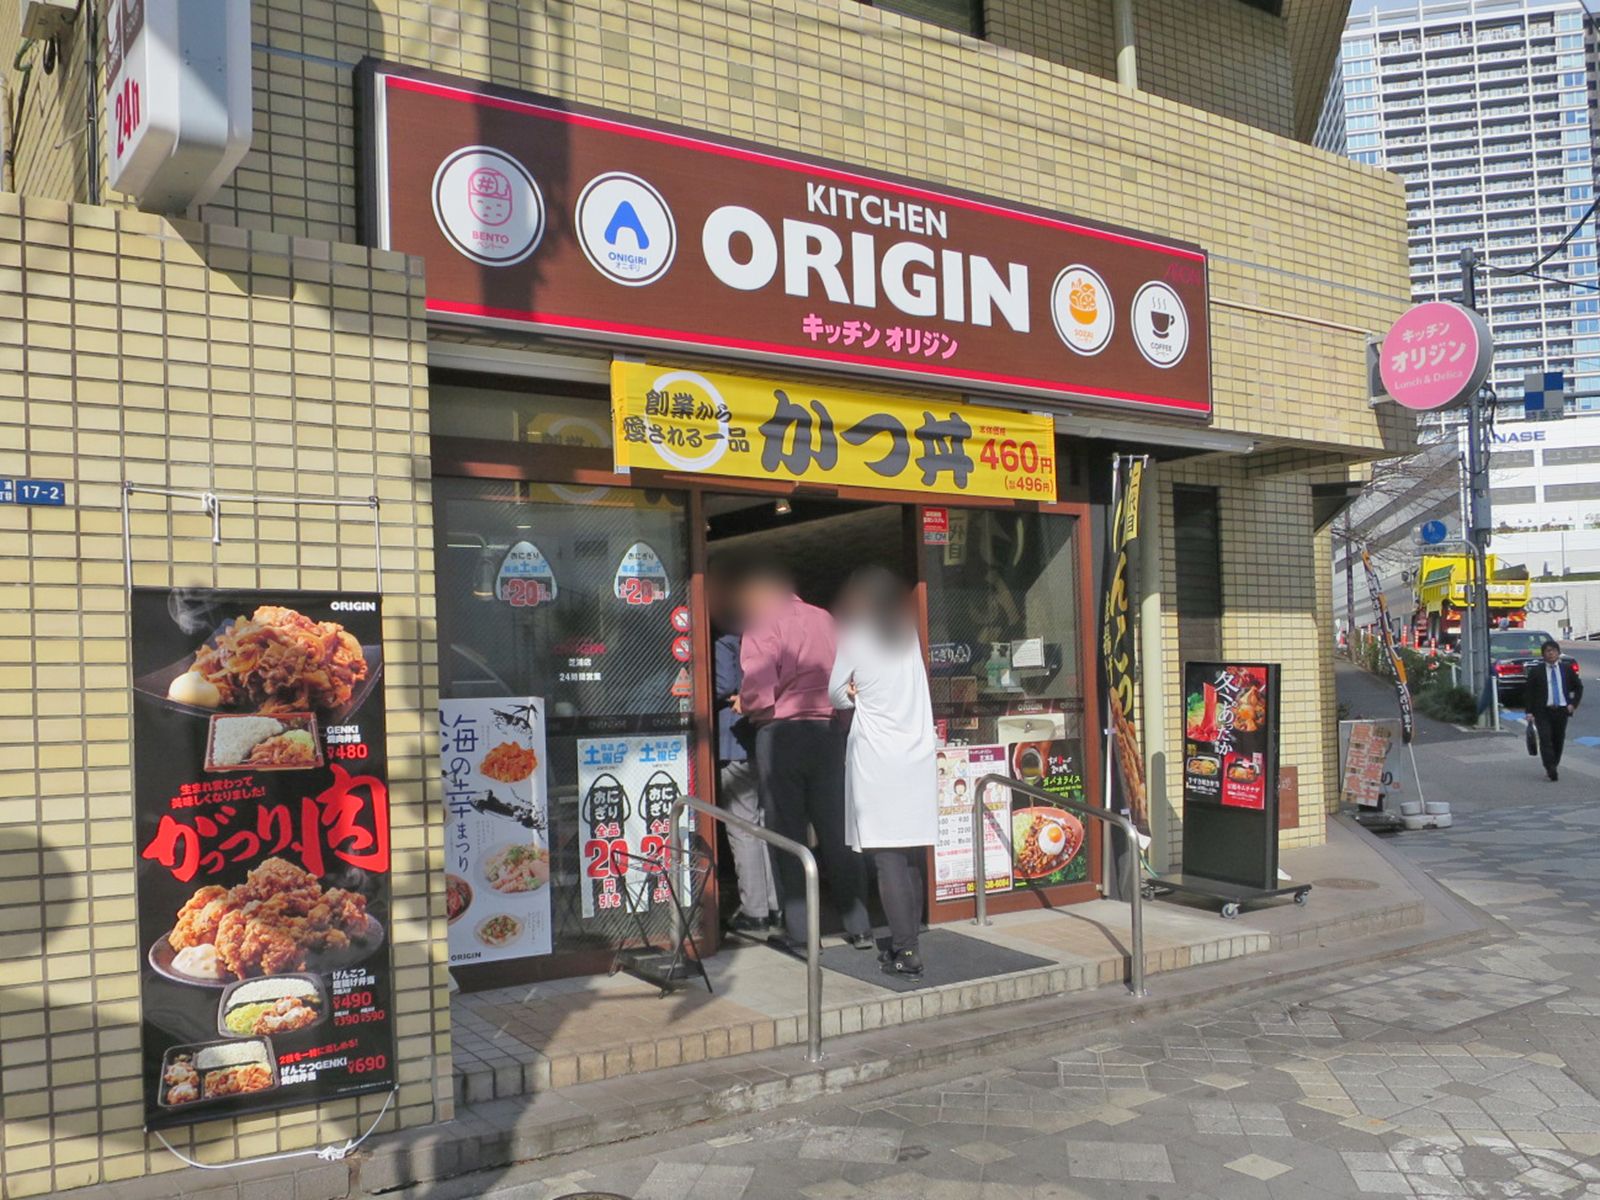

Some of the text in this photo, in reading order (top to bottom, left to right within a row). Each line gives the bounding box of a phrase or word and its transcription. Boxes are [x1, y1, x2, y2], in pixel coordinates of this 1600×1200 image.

[115, 77, 140, 160] 24h
[806, 182, 948, 239] KITCHEN
[472, 230, 509, 245] BENTO
[608, 251, 647, 266] ONIGIRI
[702, 205, 1031, 333] ORIGIN
[802, 313, 958, 359] キッチン オリジン
[1402, 322, 1450, 344] キッチン
[1150, 342, 1172, 353] COFFEE
[1391, 341, 1467, 373] オリジン
[1394, 369, 1463, 390] Lunch & Delica
[645, 389, 733, 423] 創業から
[623, 416, 750, 453] 愛される一品
[758, 389, 975, 489] かつ丼
[980, 438, 1053, 474] 460円
[23, 485, 60, 500] 17-2
[509, 578, 539, 606] 20
[626, 578, 653, 605] 20
[330, 601, 376, 611] ORIGIN
[326, 725, 359, 735] GENKI
[170, 786, 266, 809] 美味しくなりました!
[180, 776, 254, 796] 生まれ変わって
[595, 823, 621, 838] 全品
[584, 839, 628, 877] 20
[451, 952, 482, 962] ORIGIN
[332, 968, 366, 980] げんこつ
